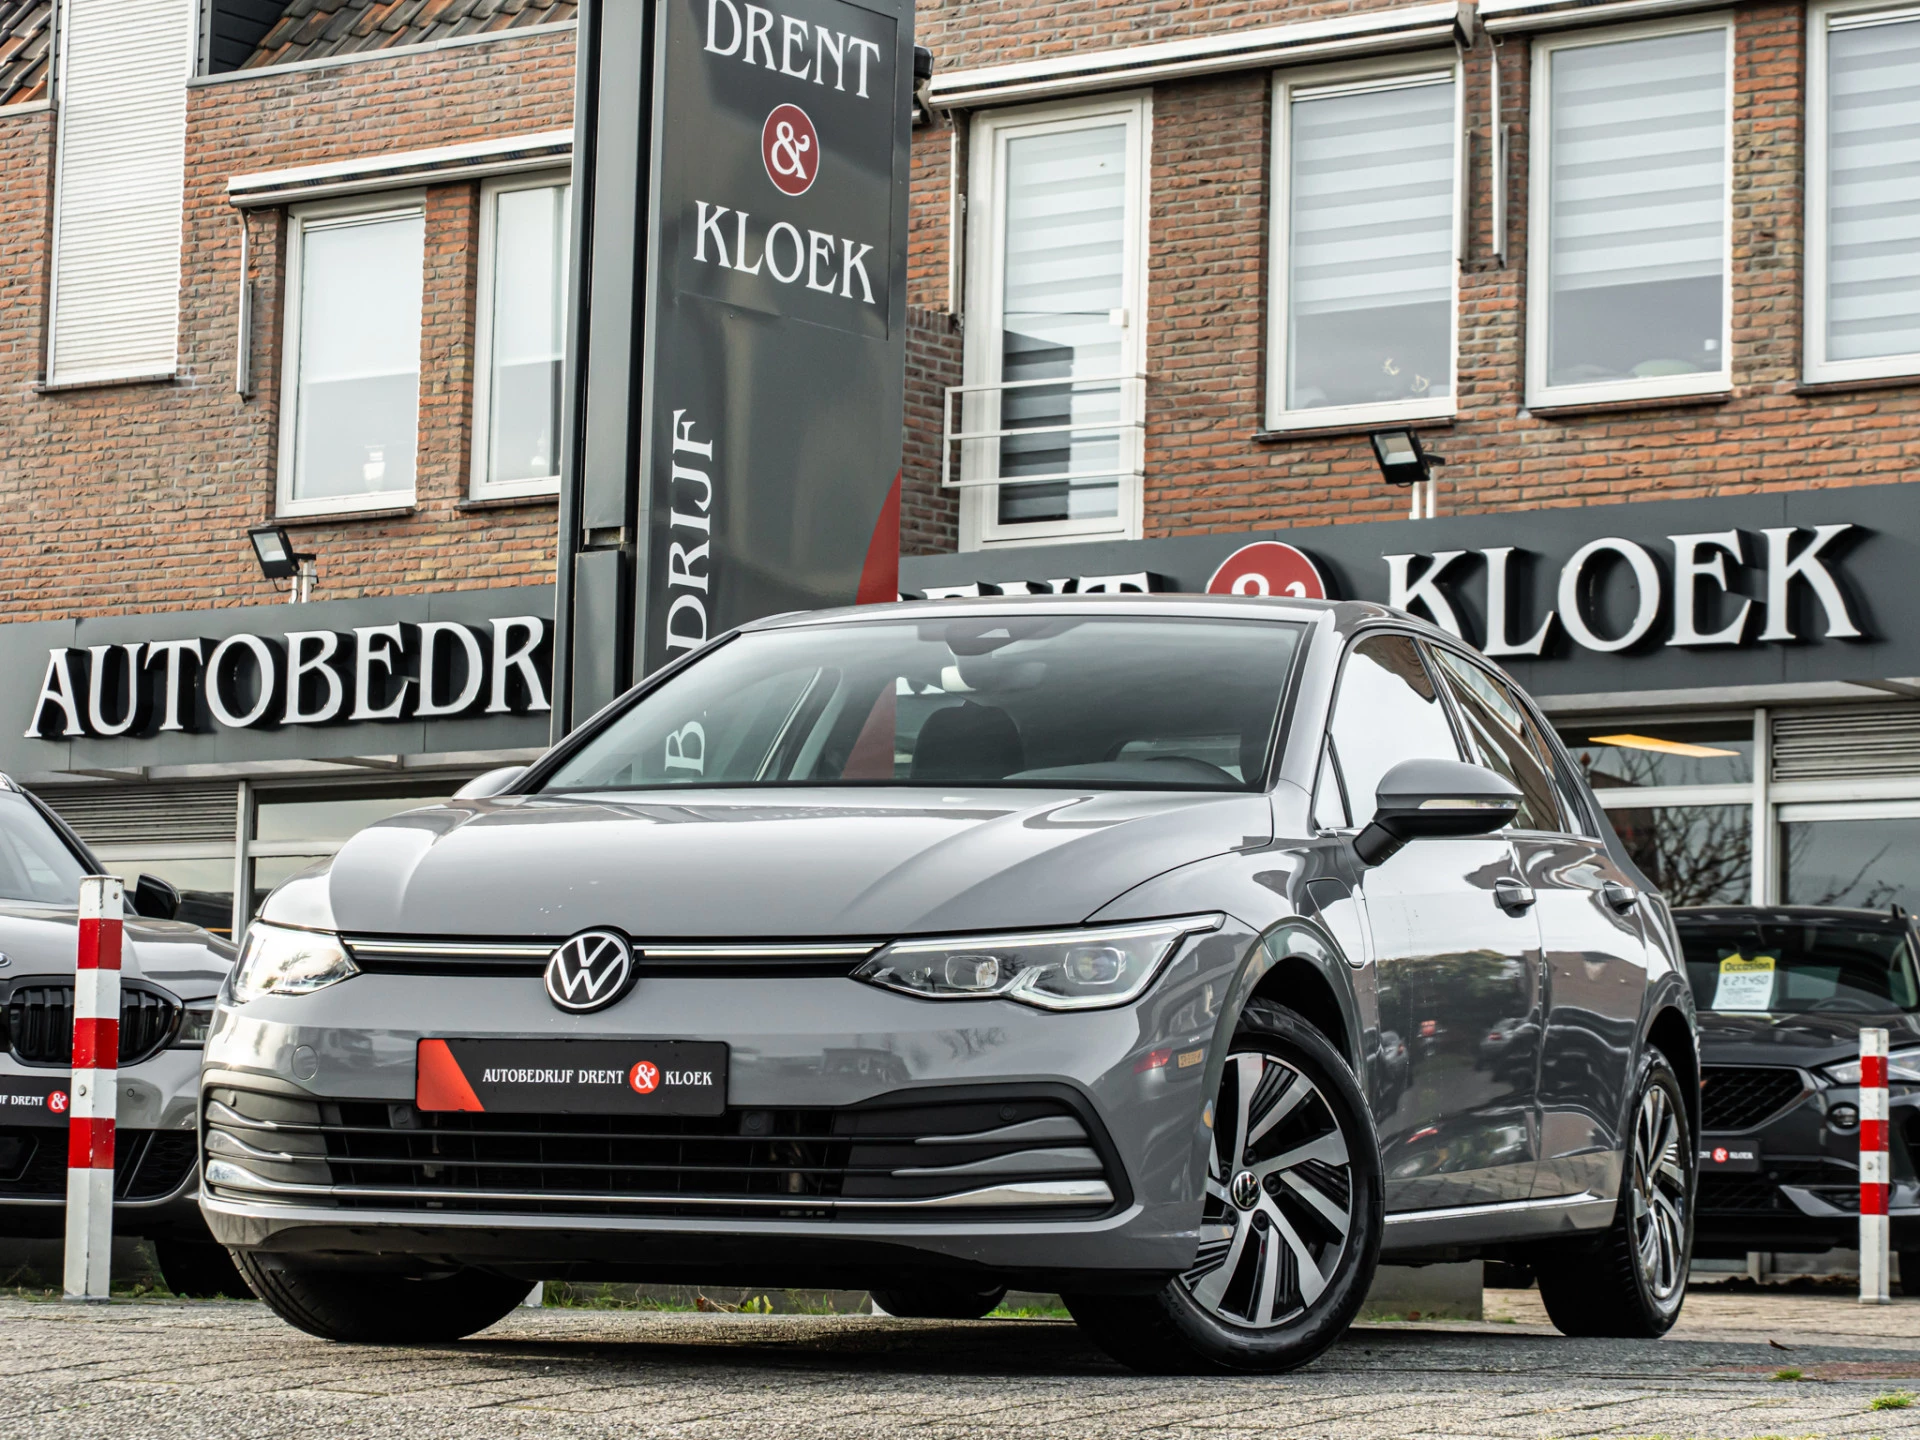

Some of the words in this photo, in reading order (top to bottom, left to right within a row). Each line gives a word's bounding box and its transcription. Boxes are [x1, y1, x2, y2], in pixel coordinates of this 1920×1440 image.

[704, 0, 880, 99] DRENT
[771, 121, 810, 180] &
[693, 200, 876, 304] KLOEK
[1382, 523, 1861, 656] KLOEK
[1724, 962, 1771, 971] Occasion
[10, 1095, 45, 1106] DRENT
[51, 1092, 67, 1110] &
[482, 1068, 574, 1084] AUTOBEDRIJF
[578, 1069, 625, 1085] DRENT
[634, 1064, 657, 1089] &
[665, 1070, 712, 1086] KLOEK
